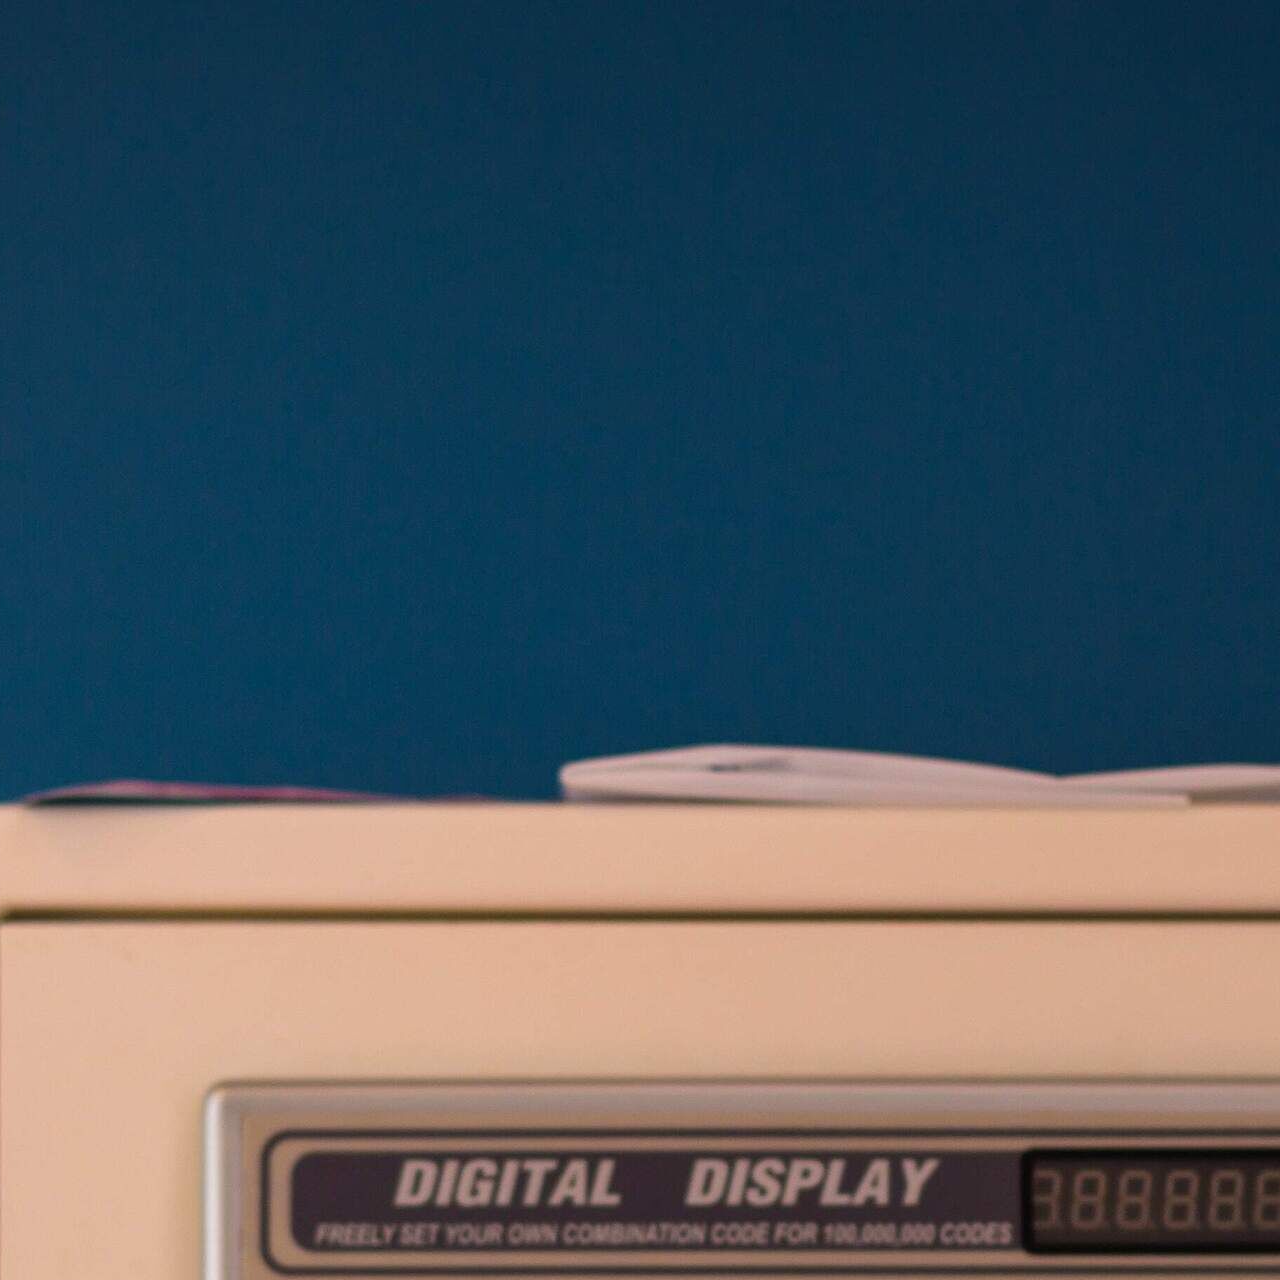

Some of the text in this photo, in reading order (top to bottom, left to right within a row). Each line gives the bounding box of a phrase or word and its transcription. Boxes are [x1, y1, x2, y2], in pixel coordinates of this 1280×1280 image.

[393, 1158, 940, 1207] DIGITAL DISPLAY
[314, 1222, 1013, 1246] FREELY SET YOUR OWN COMBINATION CODE FOR 100,000,000 CODES
